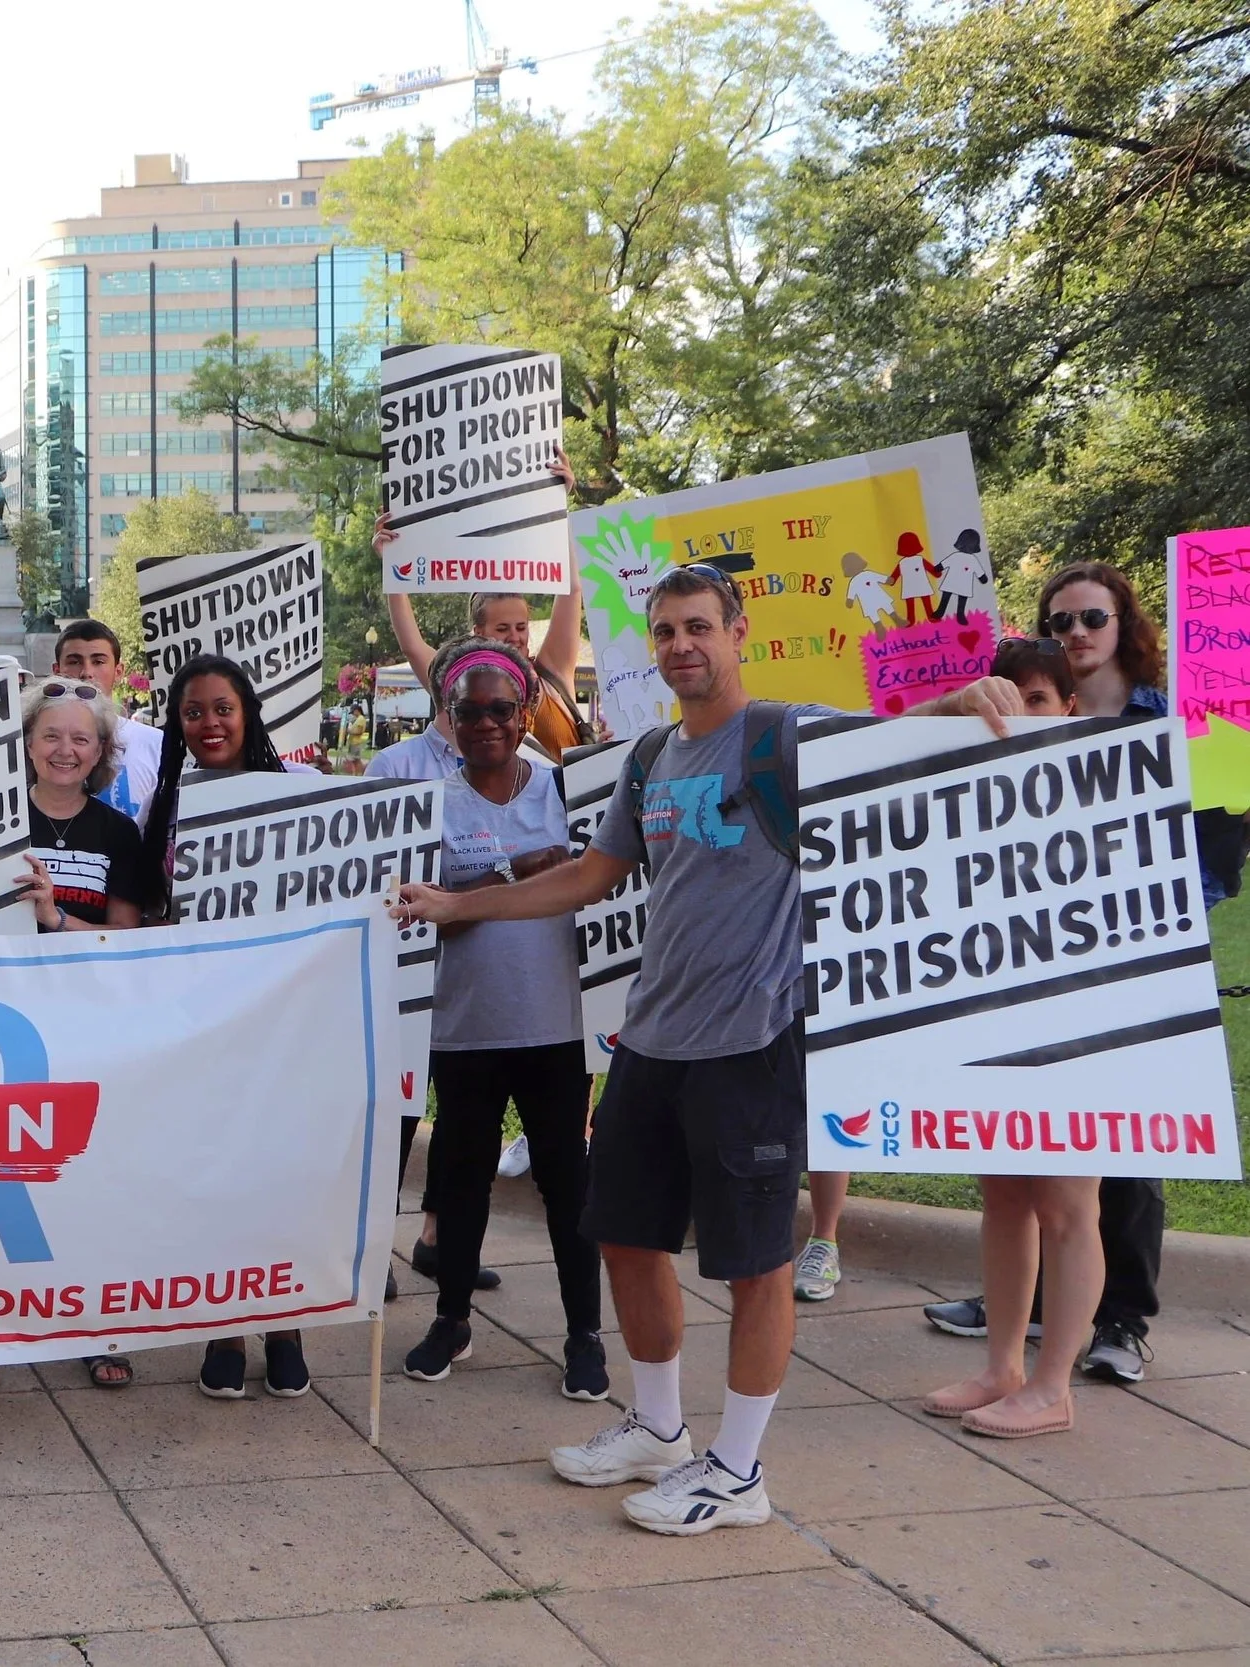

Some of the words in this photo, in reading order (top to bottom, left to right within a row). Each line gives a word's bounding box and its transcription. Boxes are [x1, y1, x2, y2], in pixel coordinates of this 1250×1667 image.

[382, 360, 556, 433] SHUTDOWN
[382, 427, 446, 474] FOR
[458, 398, 563, 450] PROFIT
[683, 526, 756, 558] LOVE
[782, 515, 832, 541] THY
[142, 549, 316, 642] SHUTDOWN
[416, 557, 426, 586] OUR
[430, 559, 563, 583] REVOLUTION
[214, 586, 322, 656] PROFIT
[869, 630, 951, 660] Without
[605, 670, 639, 694] REUNITE
[876, 653, 993, 690] Exception
[799, 732, 1174, 873] SHUTDOWN
[173, 791, 434, 882] SHUTDOWN
[172, 880, 259, 925] FOR
[275, 840, 442, 913] PROFIT
[451, 863, 478, 872] CLIMATE
[801, 866, 930, 944] FOR
[955, 800, 1193, 909] PROFIT
[803, 877, 1193, 1017] PRISONS!!!!
[880, 1101, 900, 1158] OUR
[911, 1108, 1216, 1155] REVOLUTION
[100, 1261, 305, 1316] ENDURE.
